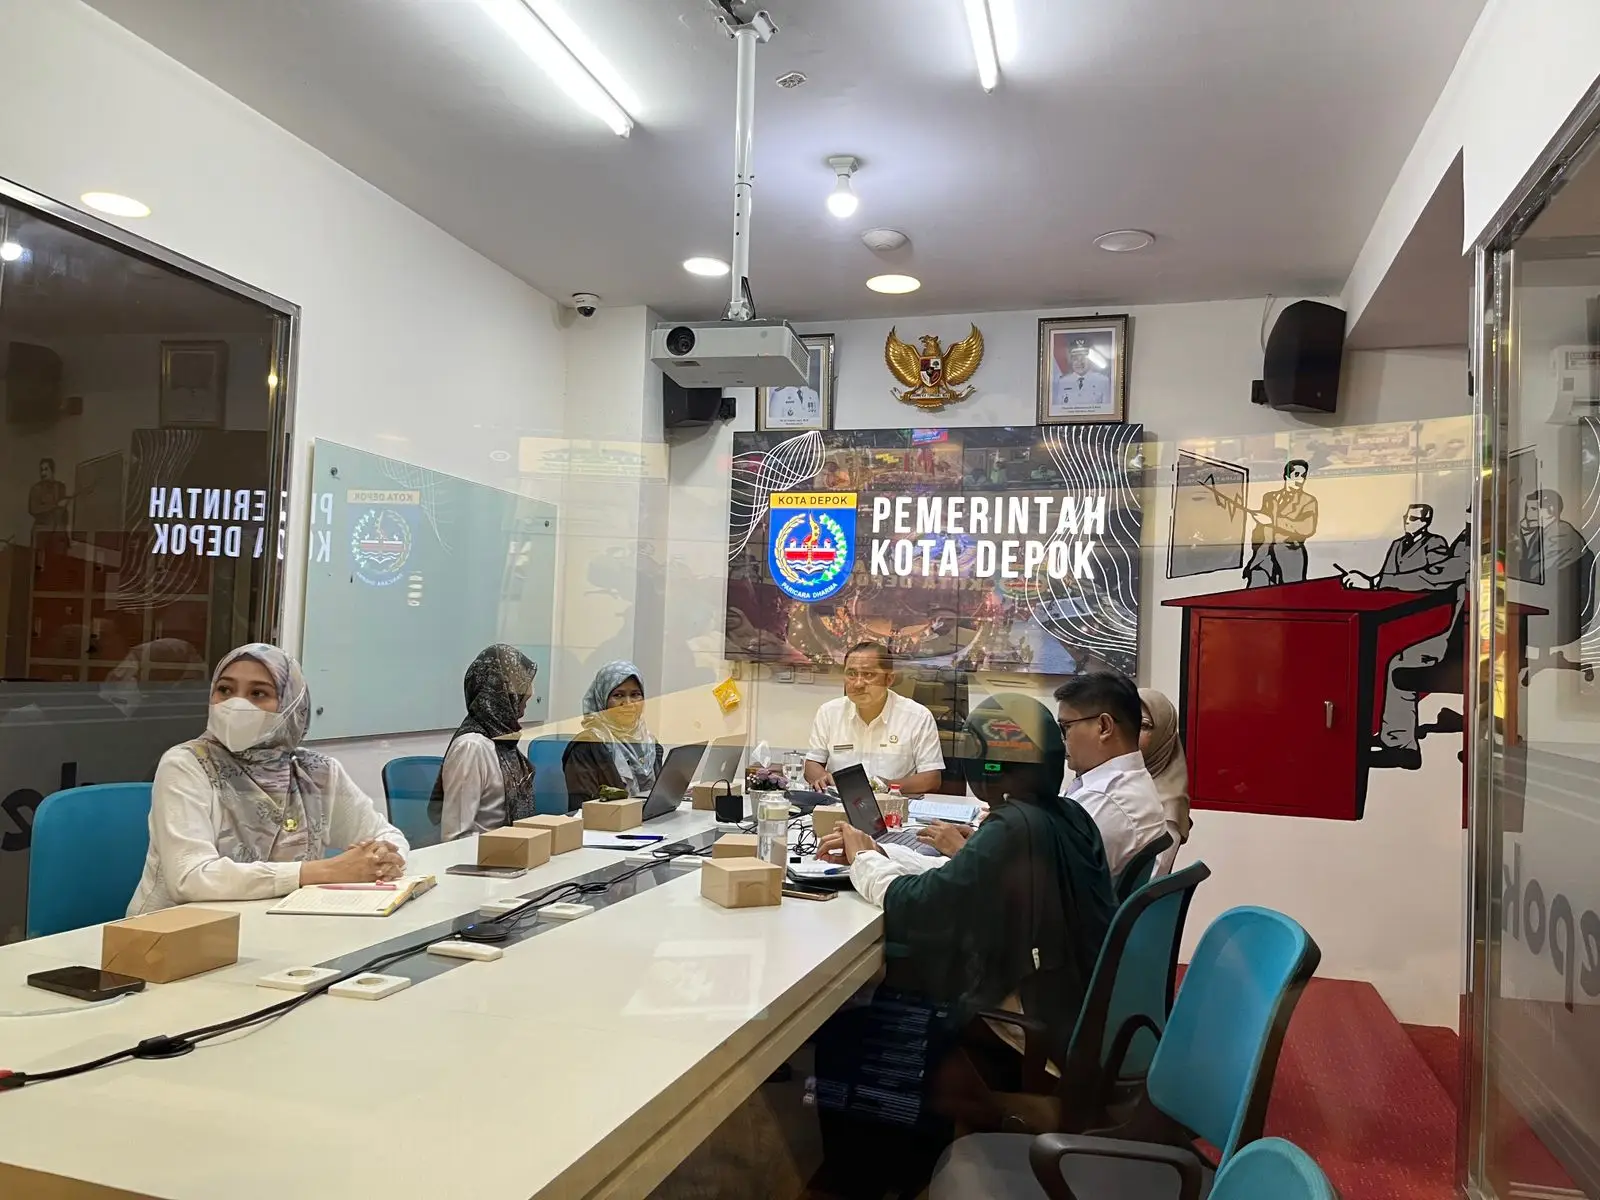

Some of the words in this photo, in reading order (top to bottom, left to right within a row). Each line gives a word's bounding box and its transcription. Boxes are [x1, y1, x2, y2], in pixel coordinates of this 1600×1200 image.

[778, 496, 807, 505] KOTA
[810, 496, 848, 505] DEPOK
[872, 495, 1107, 536] PEMERINTAH
[869, 538, 960, 579] KOTA
[976, 540, 1098, 581] DEPOK
[781, 583, 810, 598] PARICARA
[812, 583, 838, 598] DHARMA
